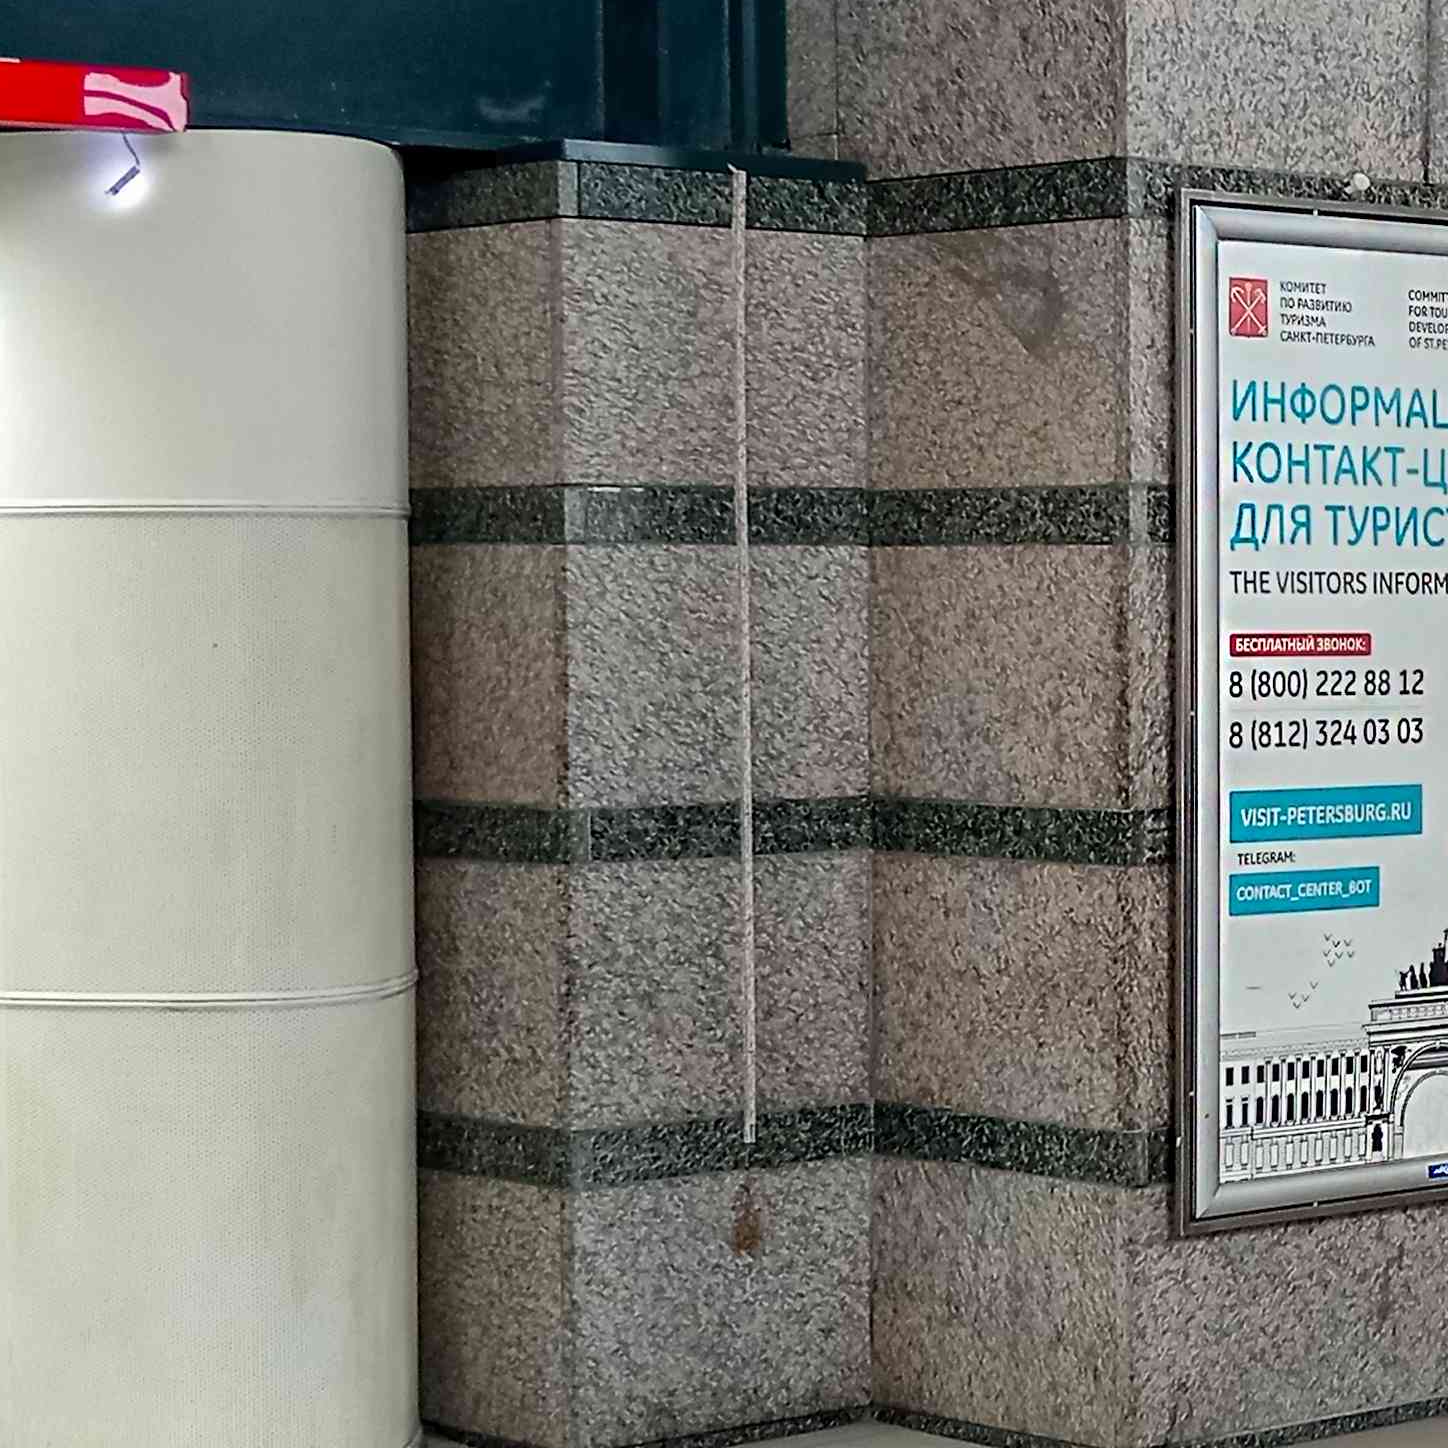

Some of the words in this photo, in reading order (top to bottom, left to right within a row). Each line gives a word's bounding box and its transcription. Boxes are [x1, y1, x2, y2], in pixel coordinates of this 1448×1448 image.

[1280, 281, 1327, 296] КОМИТЕТ
[1280, 298, 1295, 311] ПО
[1297, 299, 1353, 314] РАЗВИТИЮ
[1408, 305, 1428, 318] FOR
[1280, 314, 1327, 329] ТУРИЗМА
[1280, 329, 1376, 348] САНКТ-ПЕТЕРБУРГА
[1409, 337, 1422, 350] OF
[1229, 502, 1312, 552] ДЛЯ
[1229, 570, 1271, 595] THE
[1276, 570, 1367, 596] VISITORS
[1235, 635, 1315, 653] БЕСПЛАТНЫЙ
[1316, 636, 1366, 652] ЗВОНОК:
[1229, 672, 1244, 699] 8
[1250, 668, 1309, 701] (800)
[1315, 670, 1357, 697] 222
[1363, 670, 1391, 696] 88
[1398, 668, 1425, 696] 12
[1229, 722, 1244, 749] 8
[1250, 719, 1309, 751] (812)
[1315, 720, 1357, 746] 324
[1363, 719, 1390, 745] 03
[1397, 718, 1425, 744] 03
[1240, 802, 1413, 828] VISIT-PETERSBURG.RU
[1237, 851, 1296, 866] TELEGRAM:
[1236, 880, 1372, 901] CONTACT_CENTER_BOT
